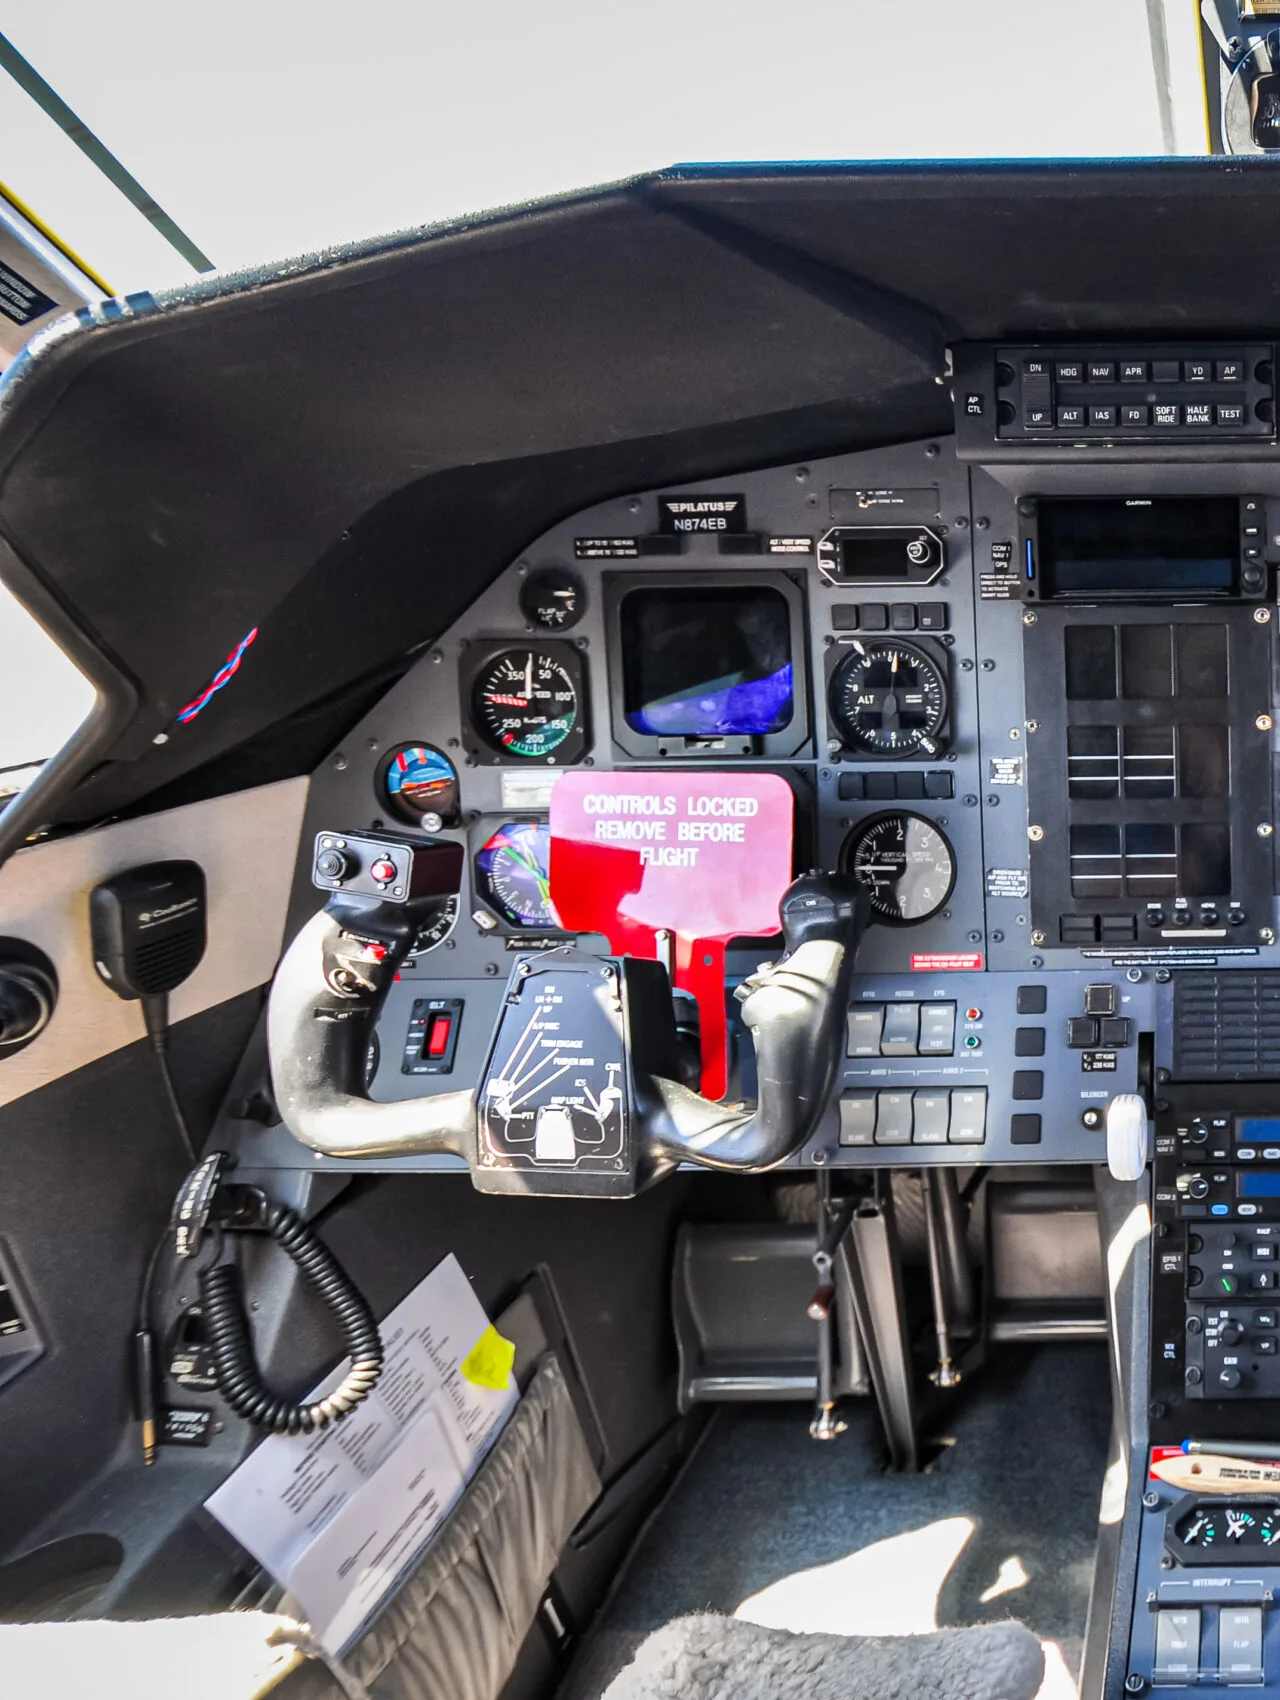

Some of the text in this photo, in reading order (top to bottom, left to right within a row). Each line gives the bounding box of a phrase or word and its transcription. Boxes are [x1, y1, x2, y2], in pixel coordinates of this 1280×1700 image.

[1030, 364, 1041, 372] DN
[1060, 367, 1076, 376] HDG
[1092, 367, 1109, 376] NAV
[1125, 367, 1142, 376] APR
[1192, 367, 1203, 376] YD
[1224, 366, 1235, 375] AP
[968, 404, 982, 413] CTL
[1156, 406, 1176, 414] SOFT
[1188, 406, 1208, 414] HALF
[1032, 413, 1042, 421] UP
[1063, 412, 1077, 420] ALT
[1096, 411, 1109, 420] IAS
[1129, 411, 1139, 419] FD
[1157, 414, 1175, 423] RIDE
[1187, 414, 1209, 423] BANK
[1220, 410, 1240, 418] TEST
[680, 502, 724, 512] PILATUS
[674, 518, 727, 530] N874EB
[507, 671, 524, 680] 350
[538, 670, 551, 679] 50
[857, 695, 875, 704] ALT
[503, 719, 521, 728] 250
[551, 720, 568, 729] 150
[525, 735, 544, 743] 200
[583, 795, 758, 816] CONTROLS LOCKED
[595, 820, 745, 842] REMOVE BEFORE
[896, 830, 903, 840] 2
[921, 837, 928, 848] 3
[640, 848, 699, 866] FLIGHT
[429, 1001, 445, 1009] ELT
[1193, 1579, 1231, 1587] INTERRUPT
